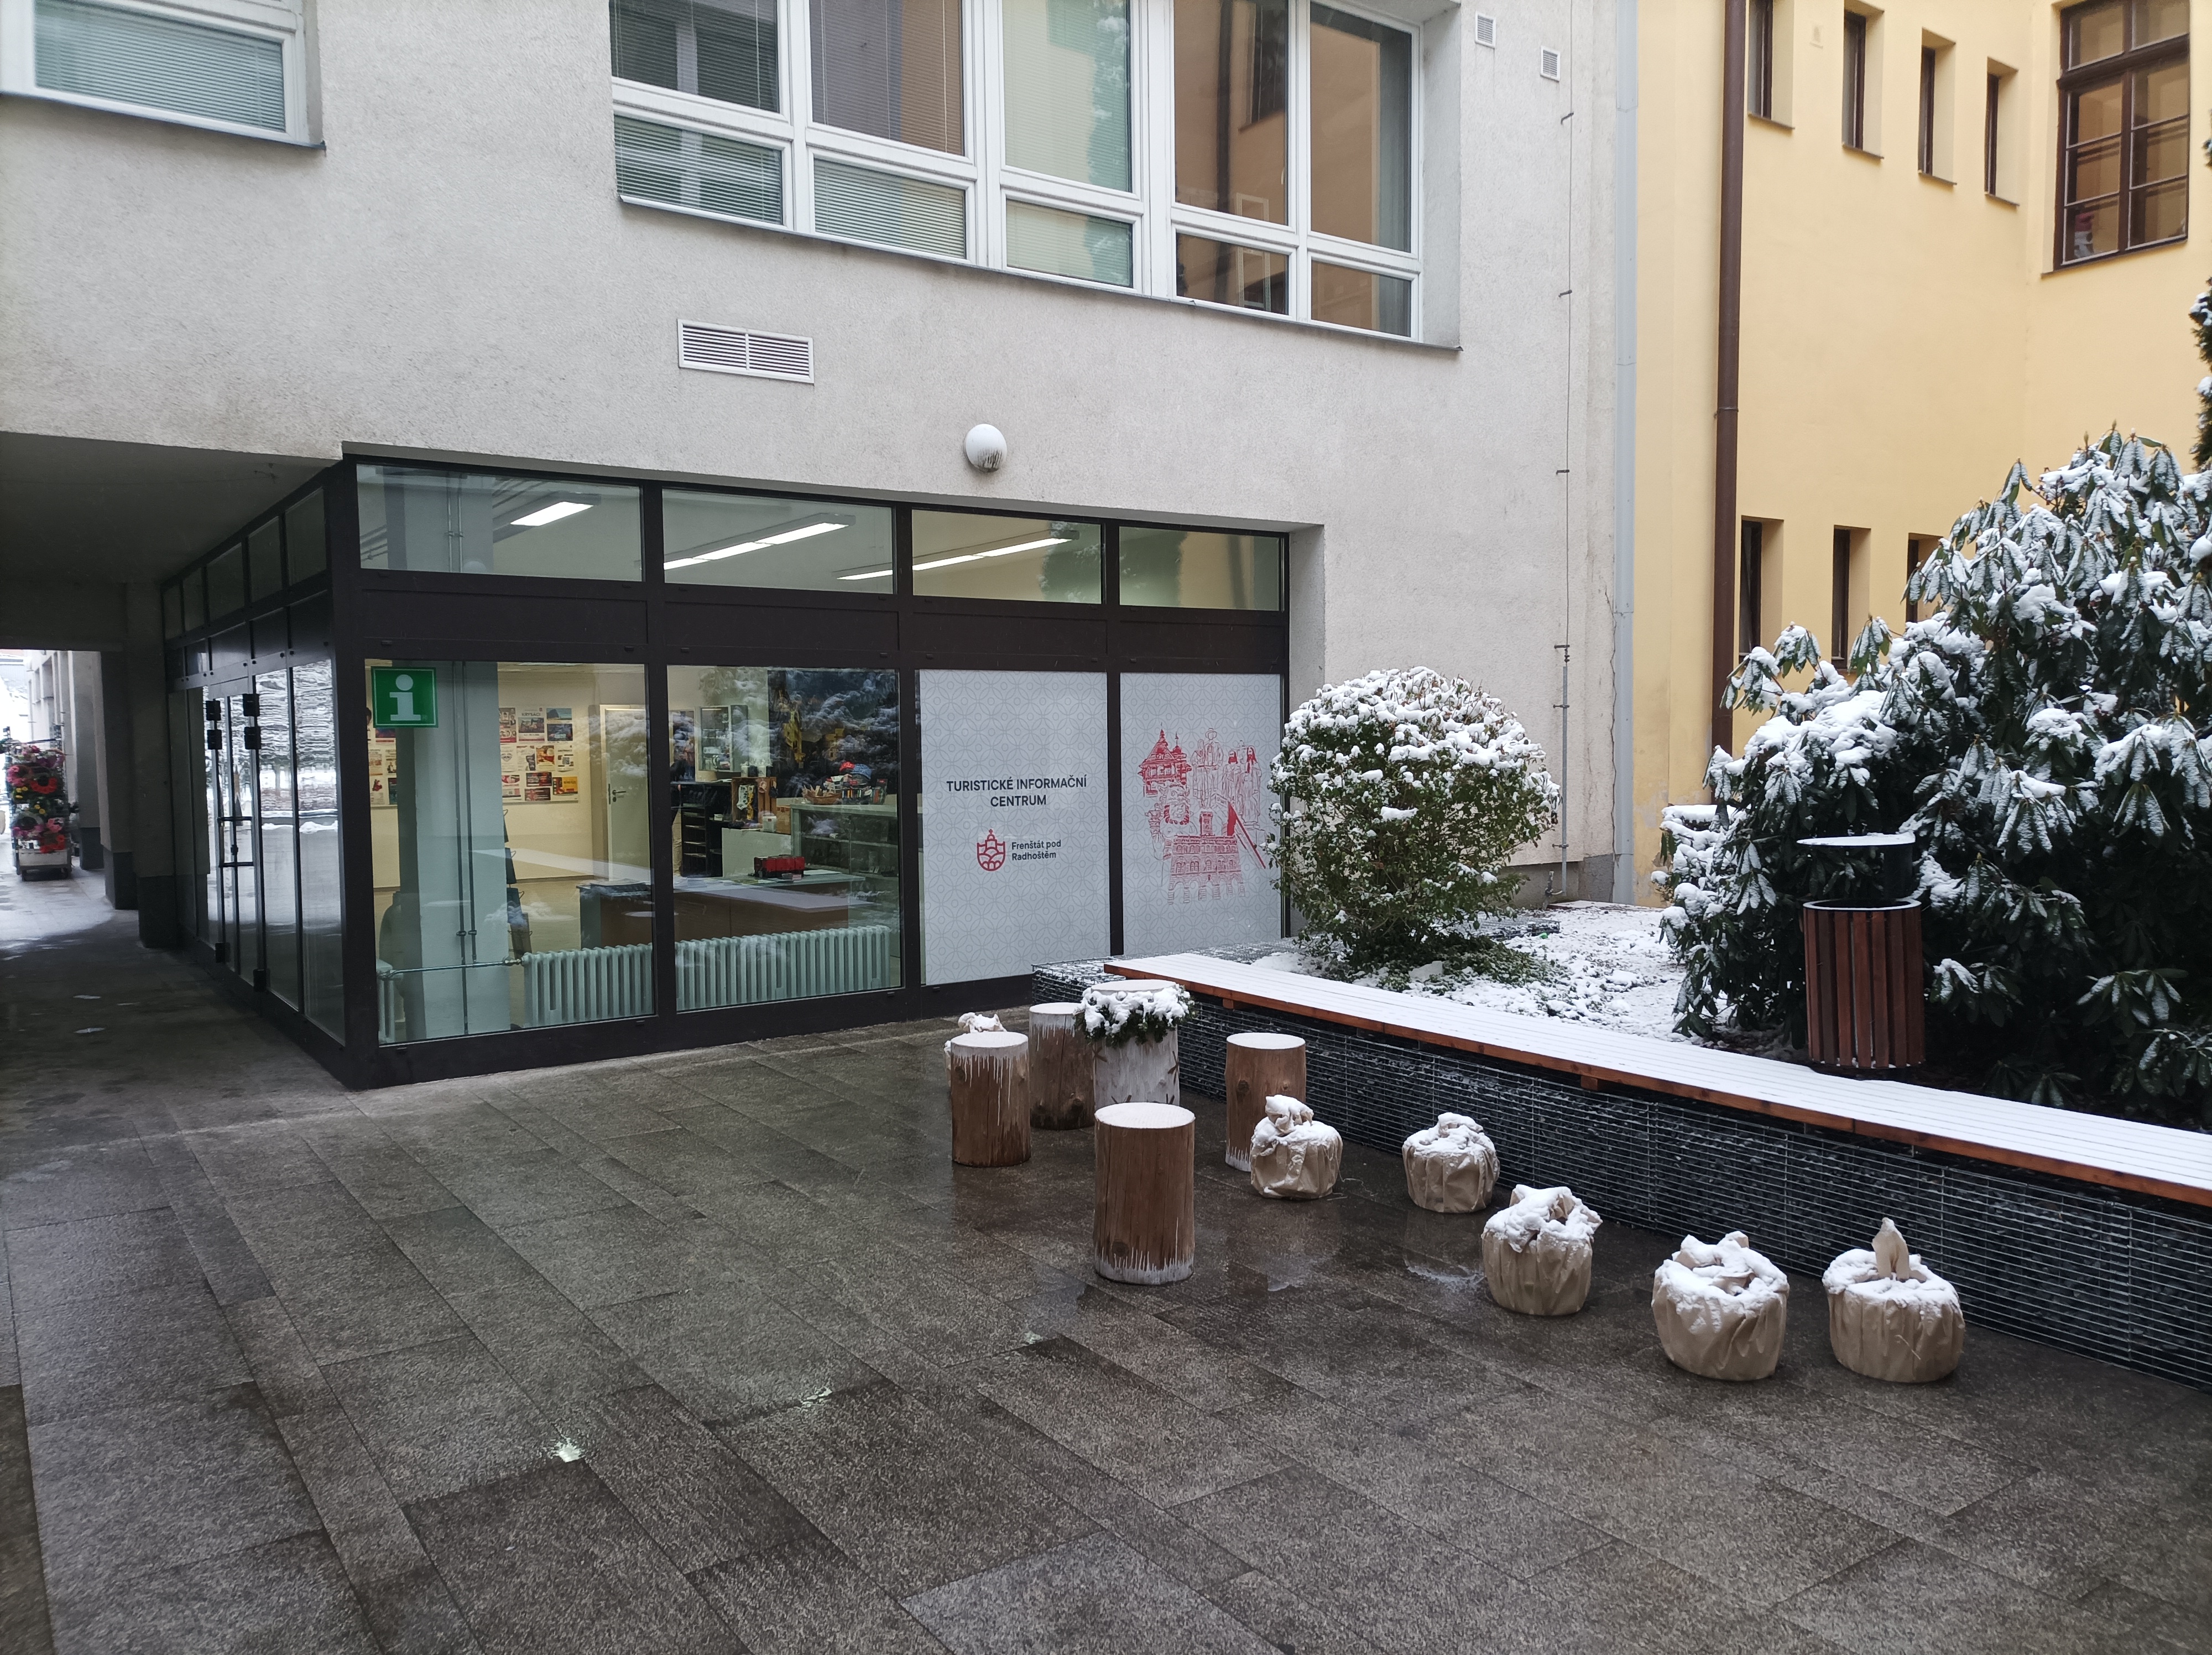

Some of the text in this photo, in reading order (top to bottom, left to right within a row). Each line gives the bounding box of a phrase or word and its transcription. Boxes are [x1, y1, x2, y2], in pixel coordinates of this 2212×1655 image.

[389, 674, 421, 721] i
[946, 774, 1087, 792] TURISTICKÉ INFORMAČNÍ
[990, 795, 1046, 806] CENTRUM
[1011, 839, 1061, 850] Frenštát pod
[1012, 851, 1056, 861] Radhoštěm
